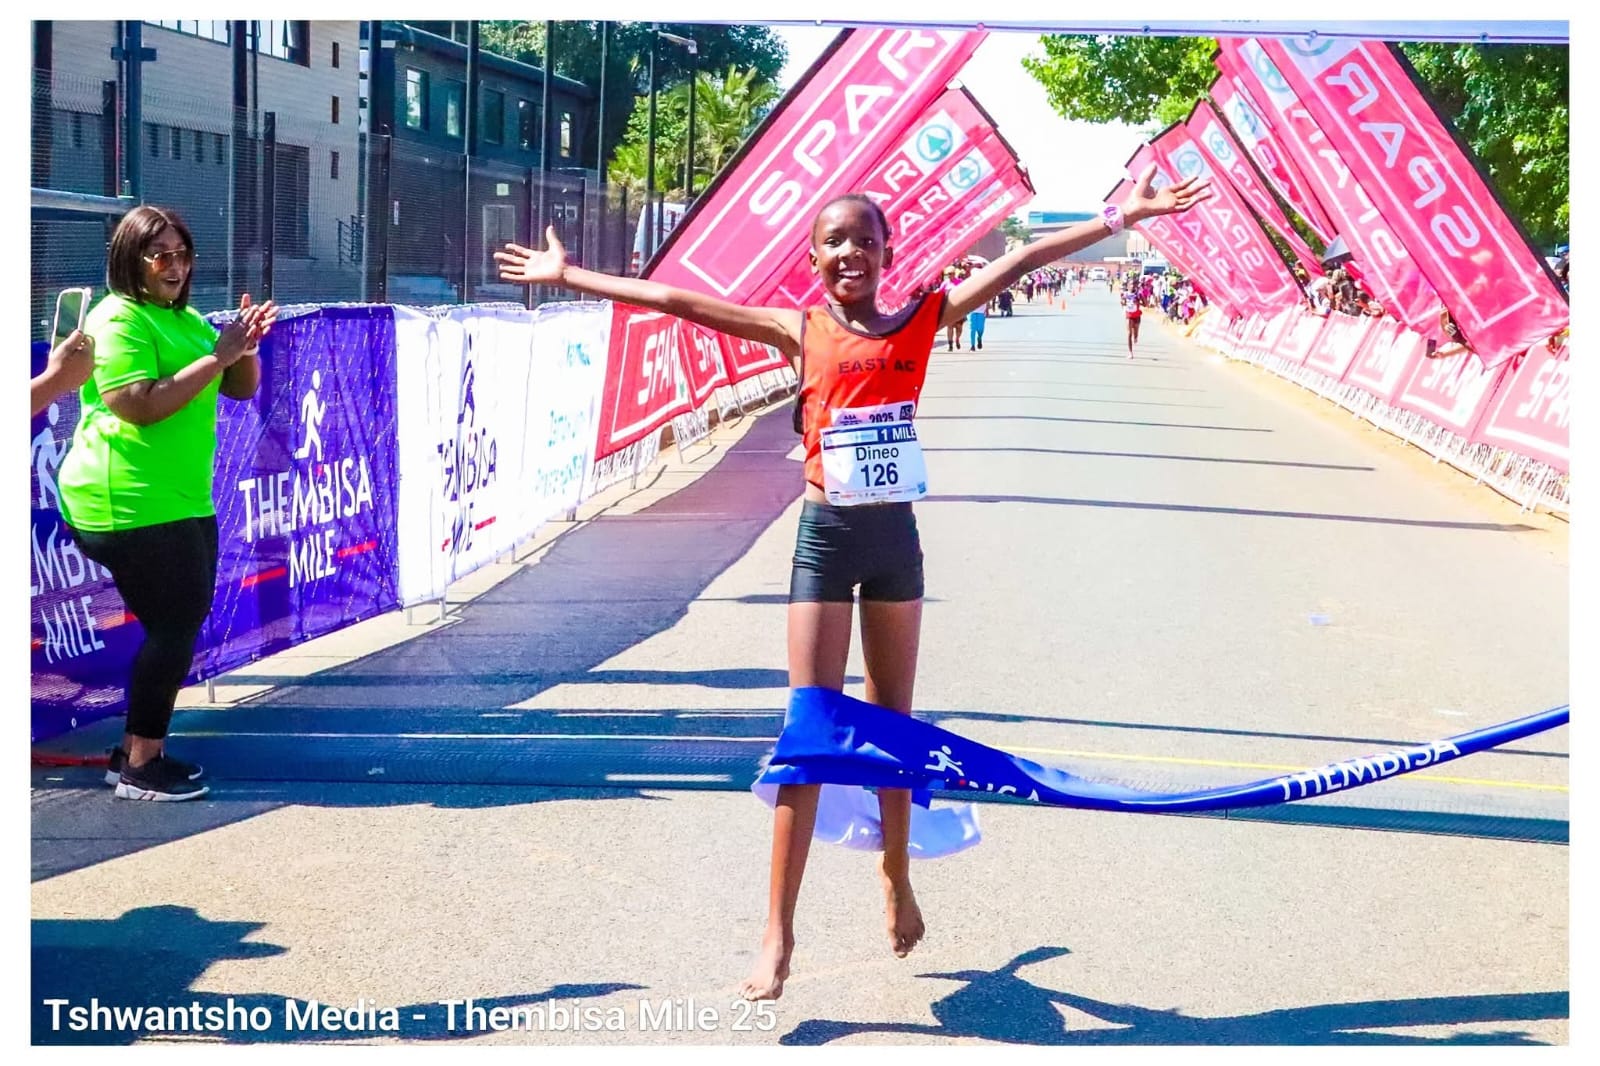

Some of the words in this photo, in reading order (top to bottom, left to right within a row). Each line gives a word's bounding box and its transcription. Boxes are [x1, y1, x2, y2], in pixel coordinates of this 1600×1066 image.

[748, 29, 936, 226] SPAR
[900, 184, 949, 236] AR
[838, 357, 888, 374] EAST
[894, 359, 916, 372] AC
[1516, 355, 1569, 429] SPA
[869, 412, 894, 423] 2025
[881, 429, 888, 441] 1
[892, 426, 916, 440] MILE
[855, 446, 899, 461] Dineo
[860, 462, 899, 487] 126
[239, 456, 374, 543] THEMBISA
[289, 529, 337, 588] MILE
[41, 595, 105, 664] MILE
[1278, 740, 1462, 800] THEMBISA
